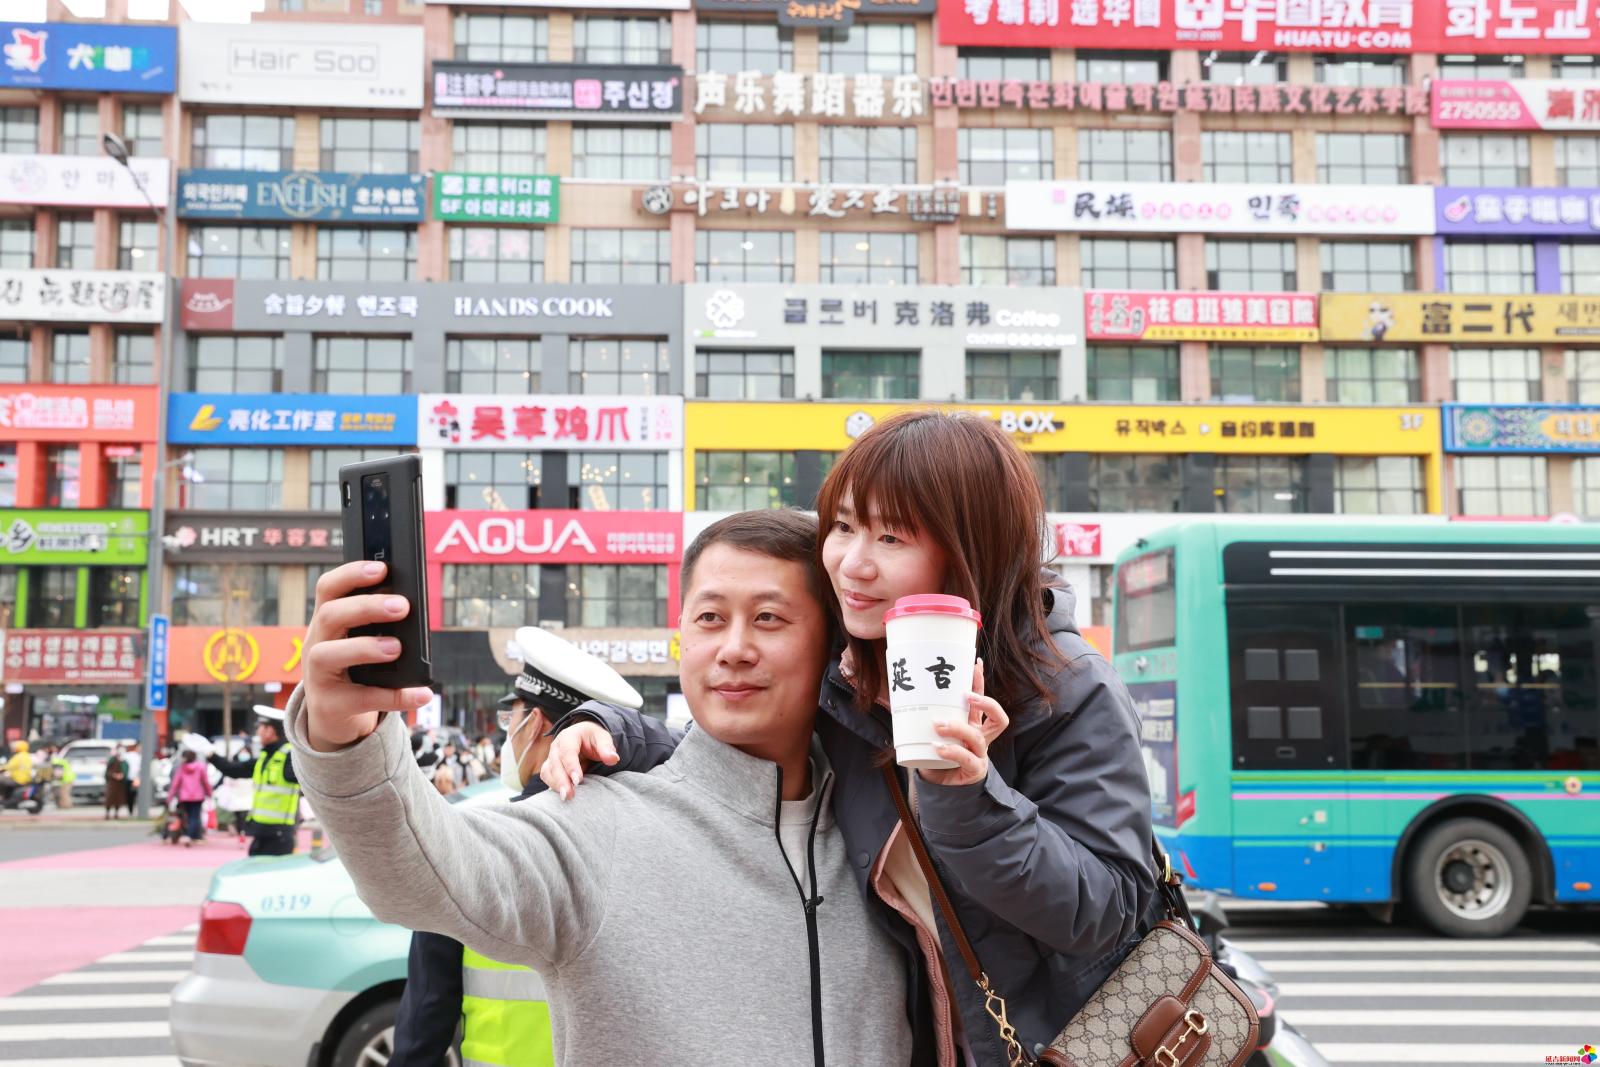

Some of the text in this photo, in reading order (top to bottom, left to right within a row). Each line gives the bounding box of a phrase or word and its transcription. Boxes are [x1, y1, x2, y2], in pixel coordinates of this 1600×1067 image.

[1446, 0, 1600, 40] 화도교
[233, 47, 376, 74] Hair Soo
[604, 80, 674, 109] 주신정
[695, 70, 923, 118] 声乐舞蹈器乐
[1184, 85, 1430, 116] 延边民族文化艺术学院
[1439, 101, 1521, 120] 2750555
[256, 181, 347, 208] ENGLISH
[1073, 191, 1138, 219] 民族
[1247, 194, 1300, 221] 민족
[453, 297, 614, 318] HANDS COOK
[894, 300, 990, 327] 克洛弗
[995, 308, 1061, 328] Coffee
[1421, 302, 1535, 336] 富二代
[228, 409, 336, 432] 亮化工作室
[1000, 410, 1056, 434] BOX
[200, 526, 259, 547] HRT
[433, 517, 598, 554] AQUA
[892, 656, 956, 692] 延吉
[261, 894, 312, 913] 0319
